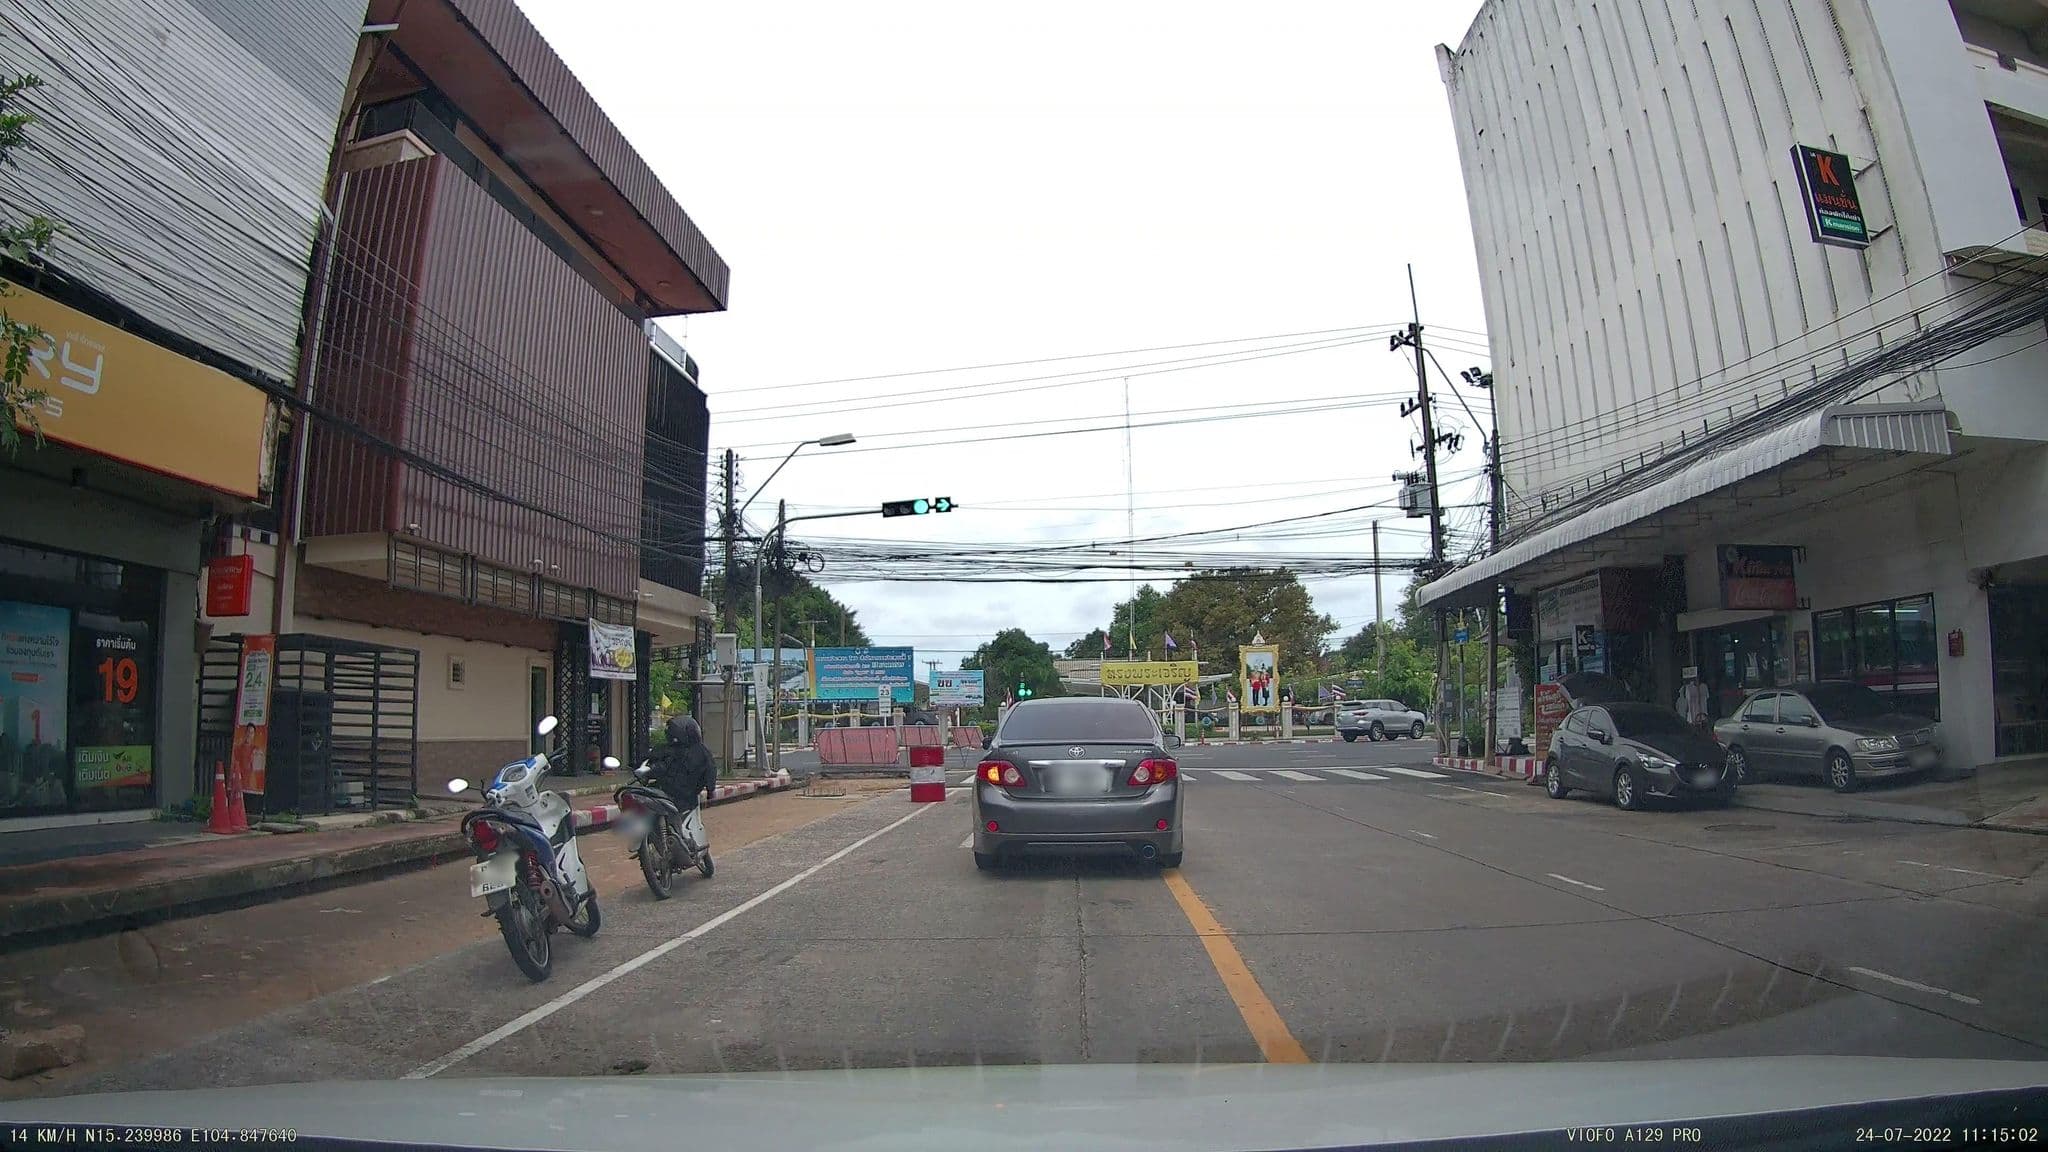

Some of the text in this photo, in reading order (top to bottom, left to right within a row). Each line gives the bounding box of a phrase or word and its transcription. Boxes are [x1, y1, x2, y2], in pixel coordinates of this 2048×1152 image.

[1816, 154, 1840, 186] K
[98, 656, 138, 704] 19
[1107, 663, 1192, 682] ทรงพระเจริญ
